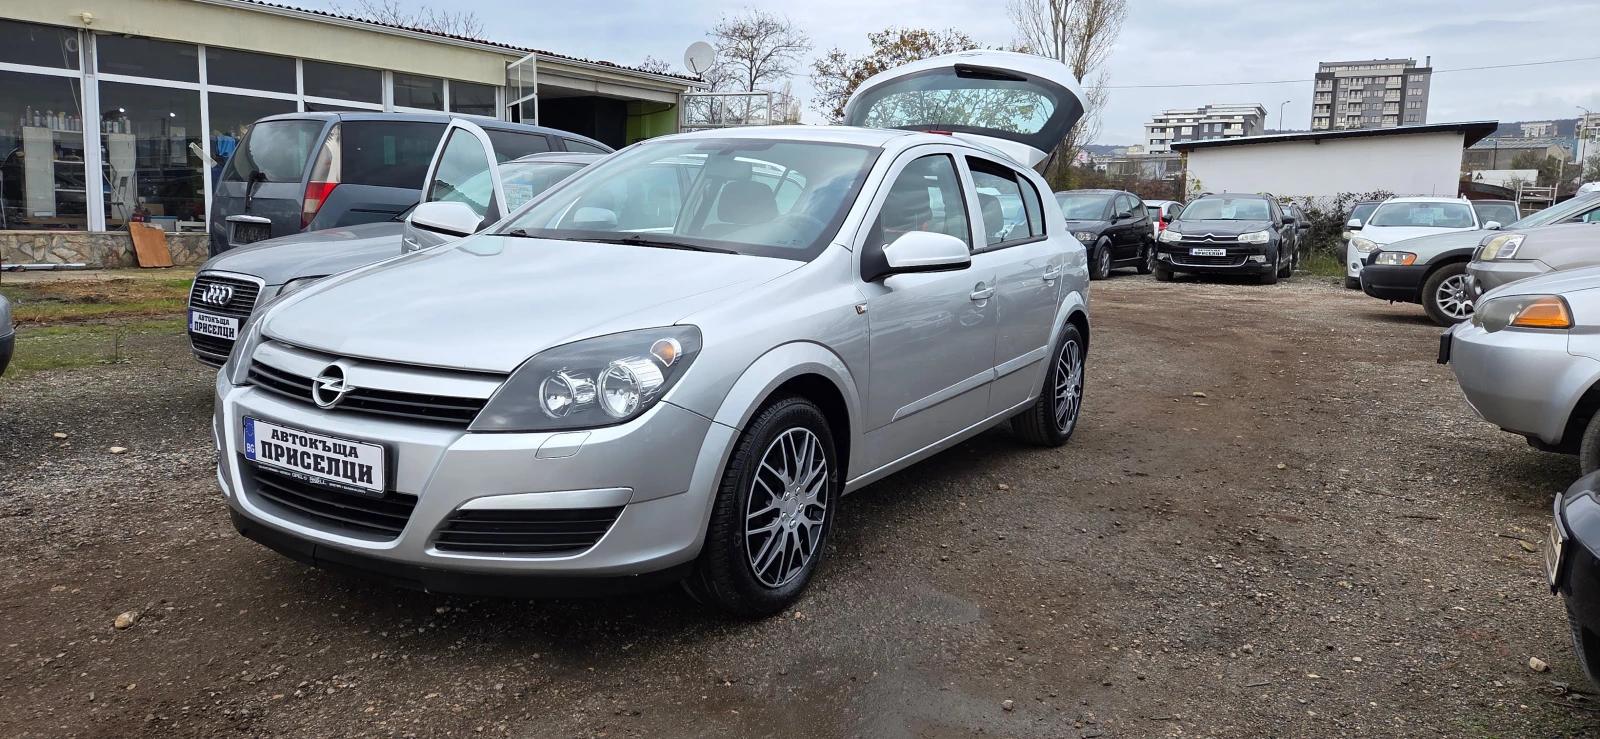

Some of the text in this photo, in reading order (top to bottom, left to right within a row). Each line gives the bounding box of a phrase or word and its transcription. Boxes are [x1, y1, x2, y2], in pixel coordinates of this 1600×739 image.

[198, 314, 230, 326] АВТОКЪЩА
[194, 321, 235, 338] ПРИСЕЛЦИ
[246, 442, 255, 454] BG
[271, 429, 359, 458] АВТОКЪЩА
[260, 440, 373, 485] ПРИСЕЛЦИ
